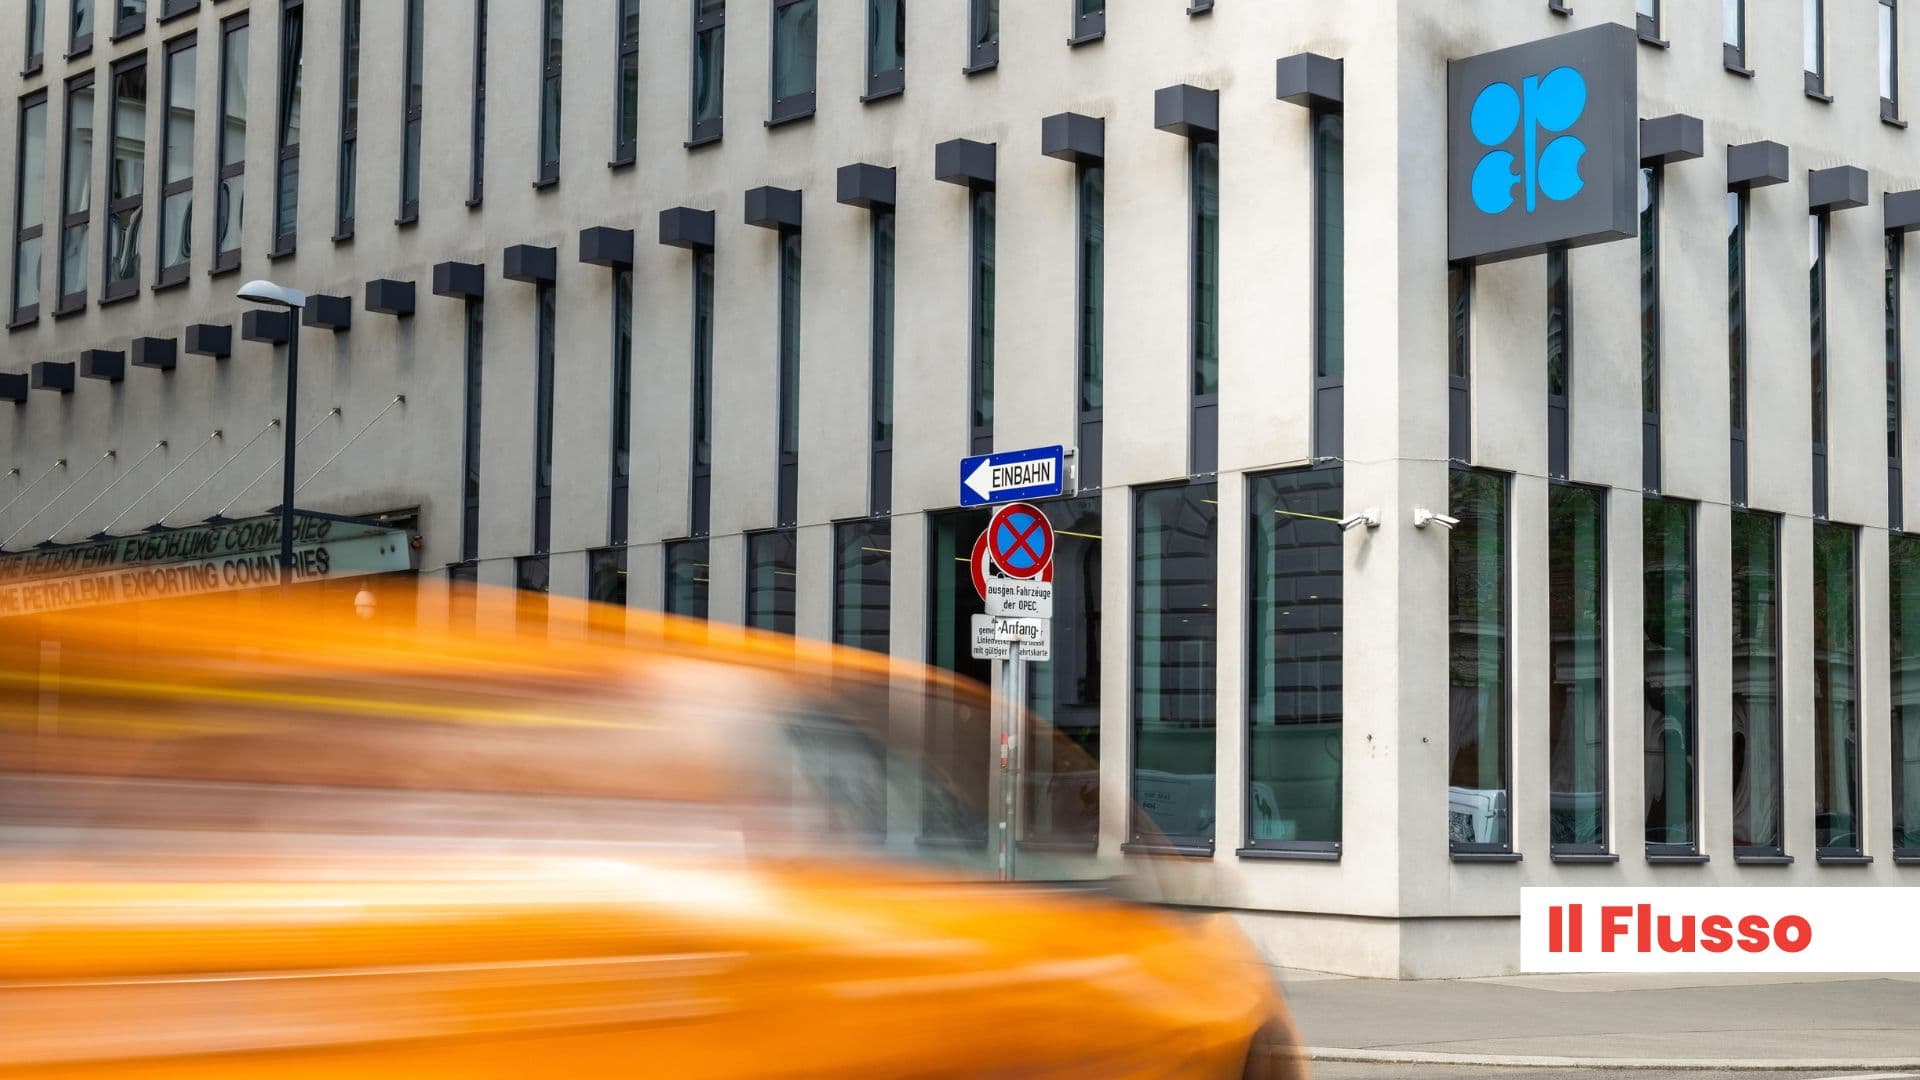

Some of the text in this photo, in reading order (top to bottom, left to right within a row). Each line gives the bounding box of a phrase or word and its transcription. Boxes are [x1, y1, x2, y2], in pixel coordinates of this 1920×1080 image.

[993, 462, 1050, 488] EINBAHN
[23, 575, 114, 610] PETROLEUM
[121, 562, 219, 599] EXPORTING
[988, 586, 1051, 600] ausgen. Fahrzeuge
[1003, 600, 1037, 611] der OPEC
[1000, 620, 1037, 639] Anfang
